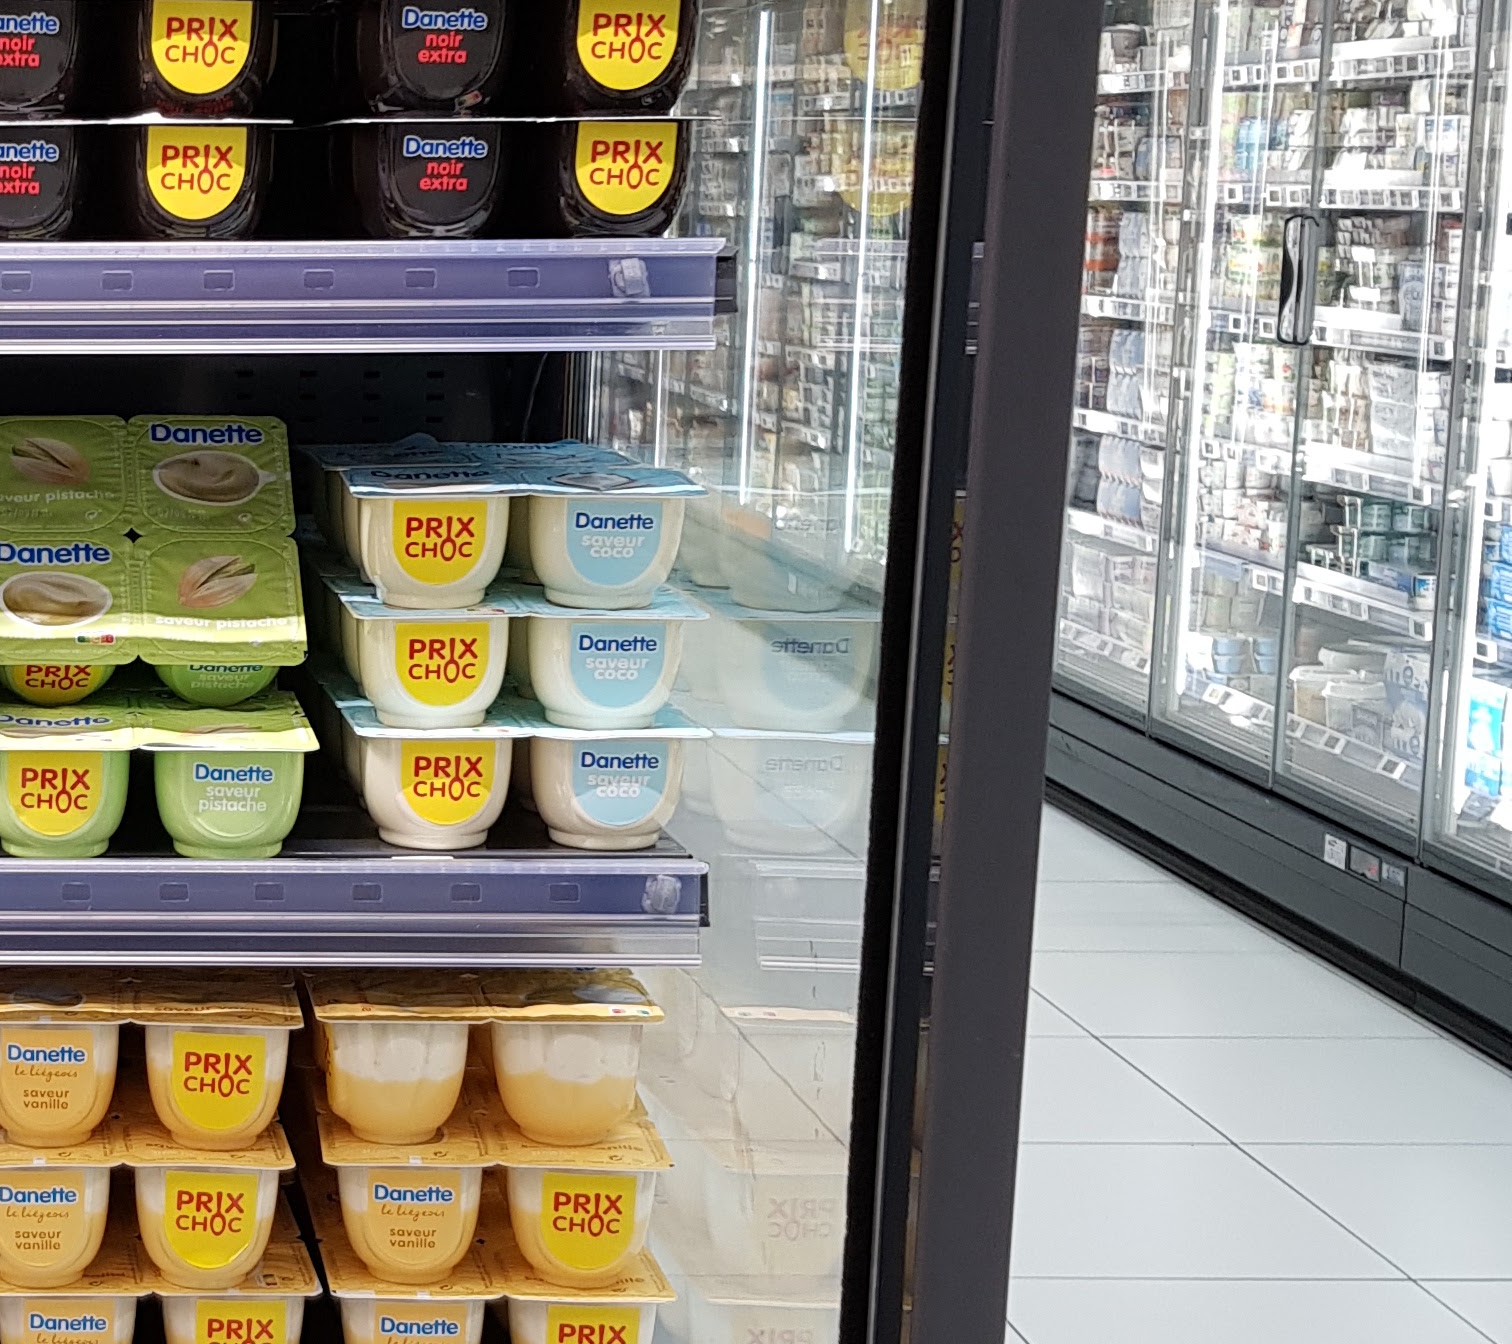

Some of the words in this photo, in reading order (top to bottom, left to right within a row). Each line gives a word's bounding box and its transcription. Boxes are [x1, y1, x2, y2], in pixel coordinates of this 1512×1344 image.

[405, 517, 474, 538] PRIX
[575, 512, 653, 530] Danette
[582, 535, 644, 547] saveur
[405, 541, 472, 561] CHOC
[590, 547, 634, 558] coco
[194, 763, 274, 783] Danette
[206, 786, 260, 798] saveur
[198, 798, 266, 812] pistache
[7, 1044, 86, 1064] Danette
[23, 1089, 69, 1098] saveur
[23, 1099, 68, 1110] vanille
